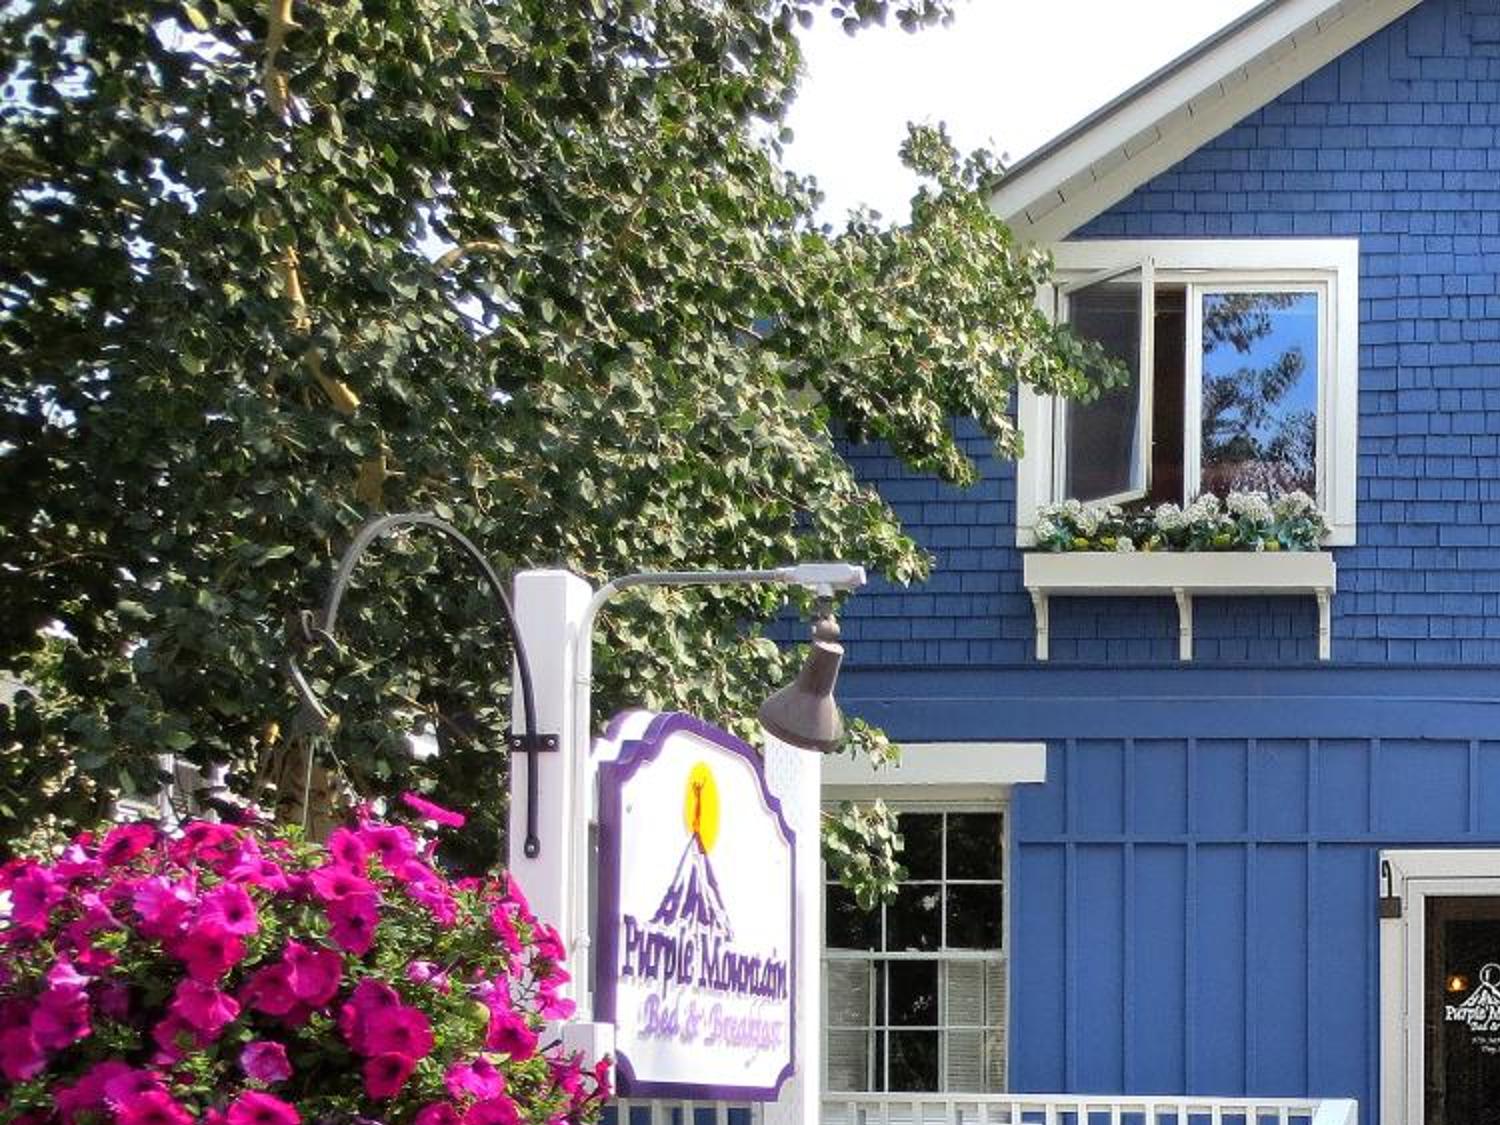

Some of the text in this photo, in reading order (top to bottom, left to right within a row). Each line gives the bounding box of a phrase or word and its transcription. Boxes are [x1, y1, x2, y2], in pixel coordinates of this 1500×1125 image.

[622, 914, 787, 999] Purple Mountain
[638, 993, 681, 1039] Bed
[680, 1001, 701, 1044] &
[1445, 1005, 1487, 1024] Purple
